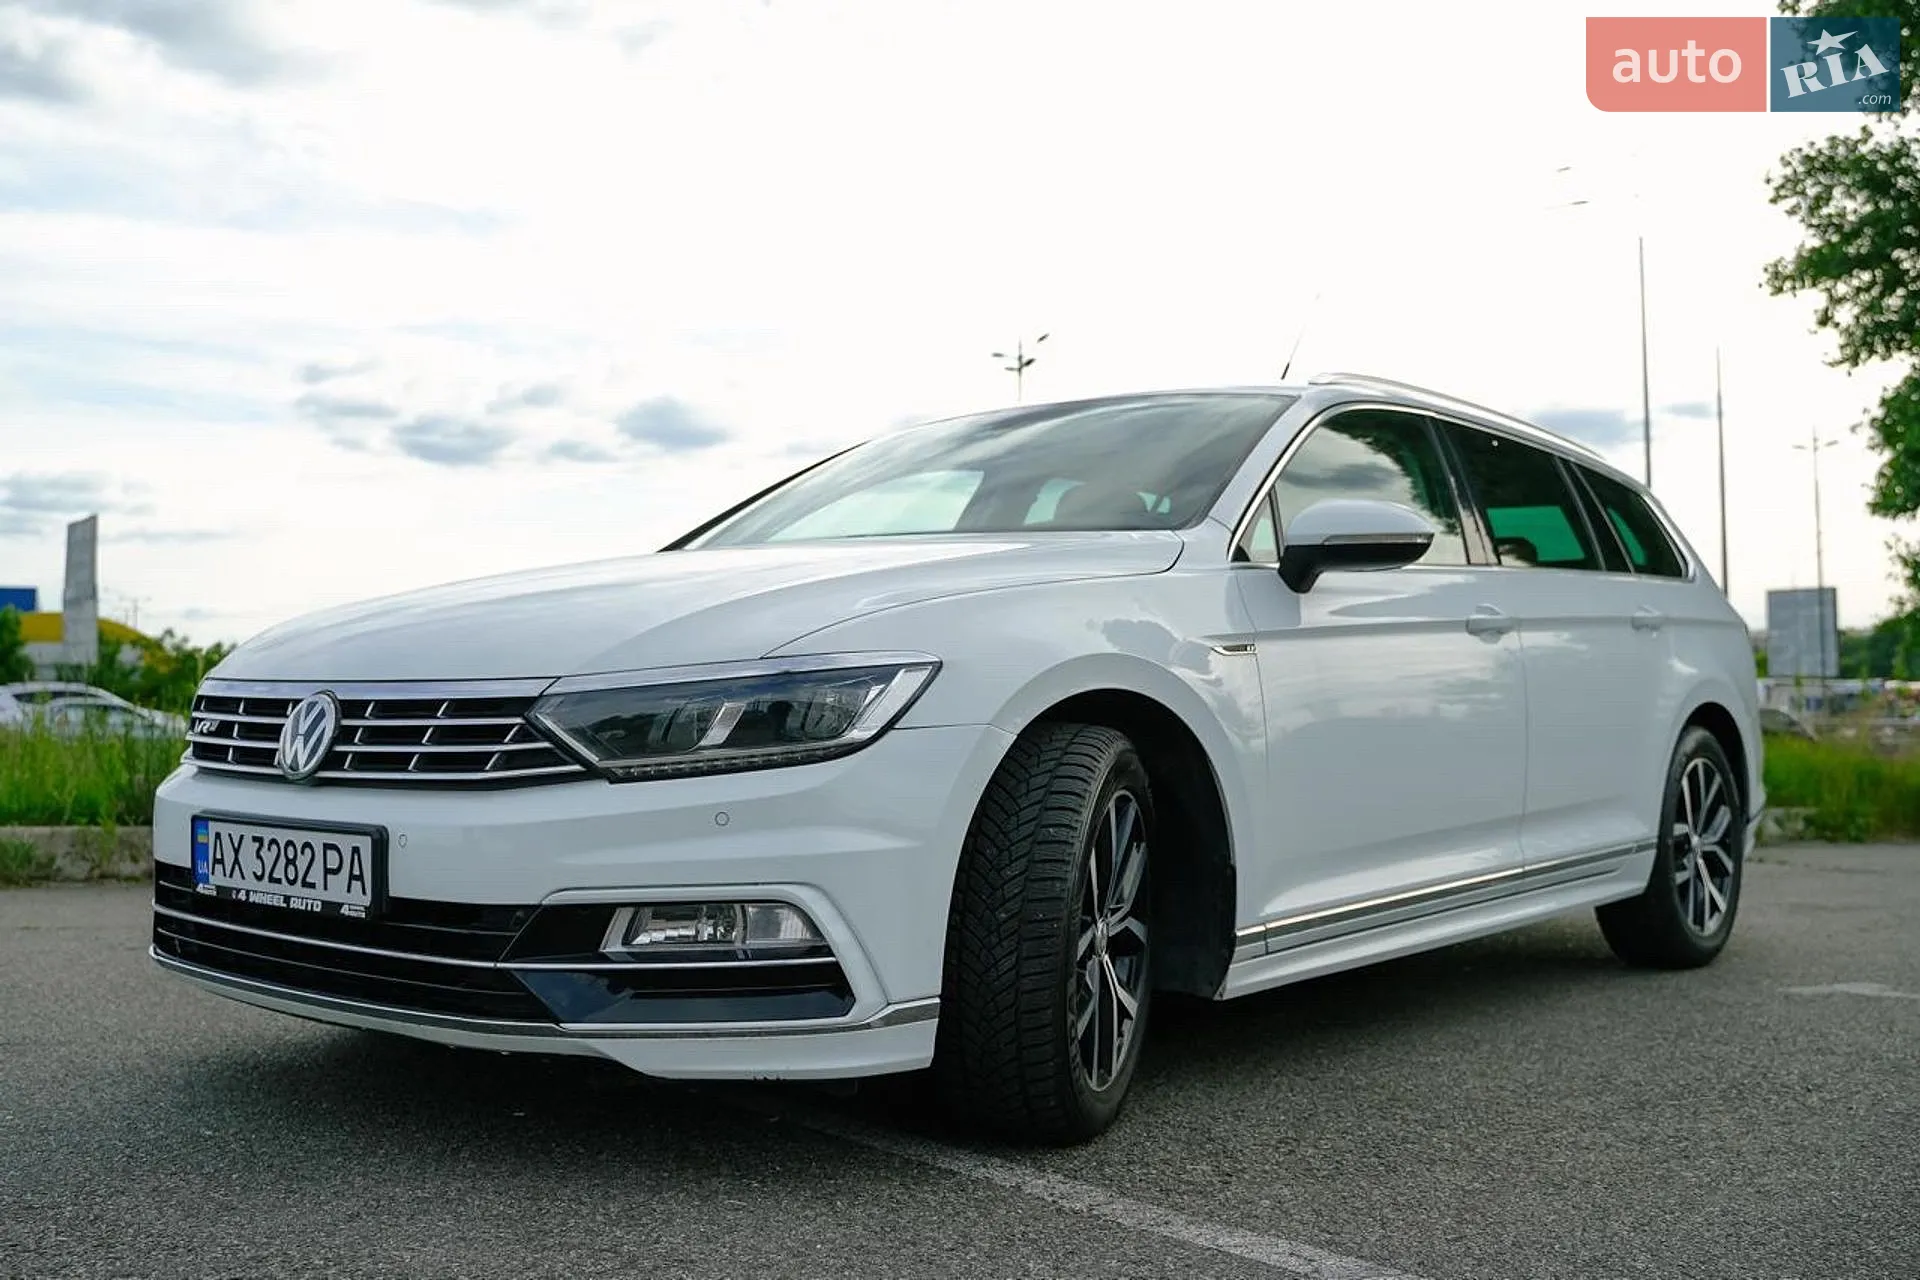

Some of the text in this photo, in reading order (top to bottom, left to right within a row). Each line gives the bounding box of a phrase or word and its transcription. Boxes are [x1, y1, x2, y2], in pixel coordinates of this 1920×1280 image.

[211, 831, 367, 896] AX 3282 PA
[249, 891, 287, 907] WHEEL
[289, 897, 322, 912] AUTO
